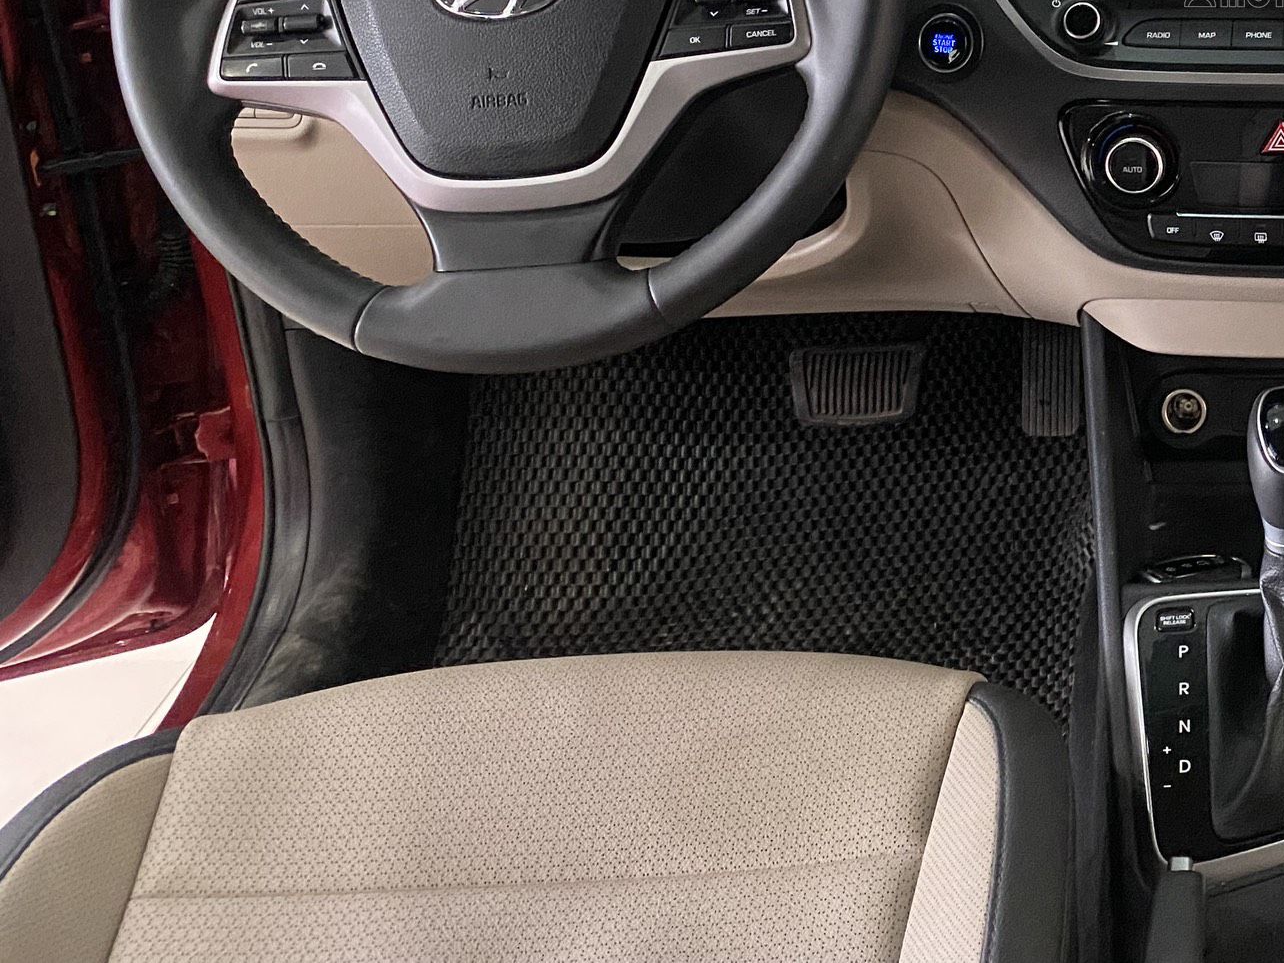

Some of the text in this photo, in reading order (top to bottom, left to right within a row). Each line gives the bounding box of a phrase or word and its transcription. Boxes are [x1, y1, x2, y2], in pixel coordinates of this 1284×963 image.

[746, 30, 777, 38] CANCEL
[1146, 31, 1171, 39] RADIO
[1198, 31, 1217, 39] MAP
[1245, 31, 1273, 39] PHONE
[689, 36, 701, 44] OK
[932, 39, 956, 47] START
[934, 46, 954, 54] STOP
[471, 93, 529, 109] AIRBAG
[1166, 226, 1179, 234] OFF
[1178, 645, 1190, 659] P
[1178, 682, 1190, 696] R
[1178, 719, 1191, 733] N
[1178, 759, 1192, 774] D
